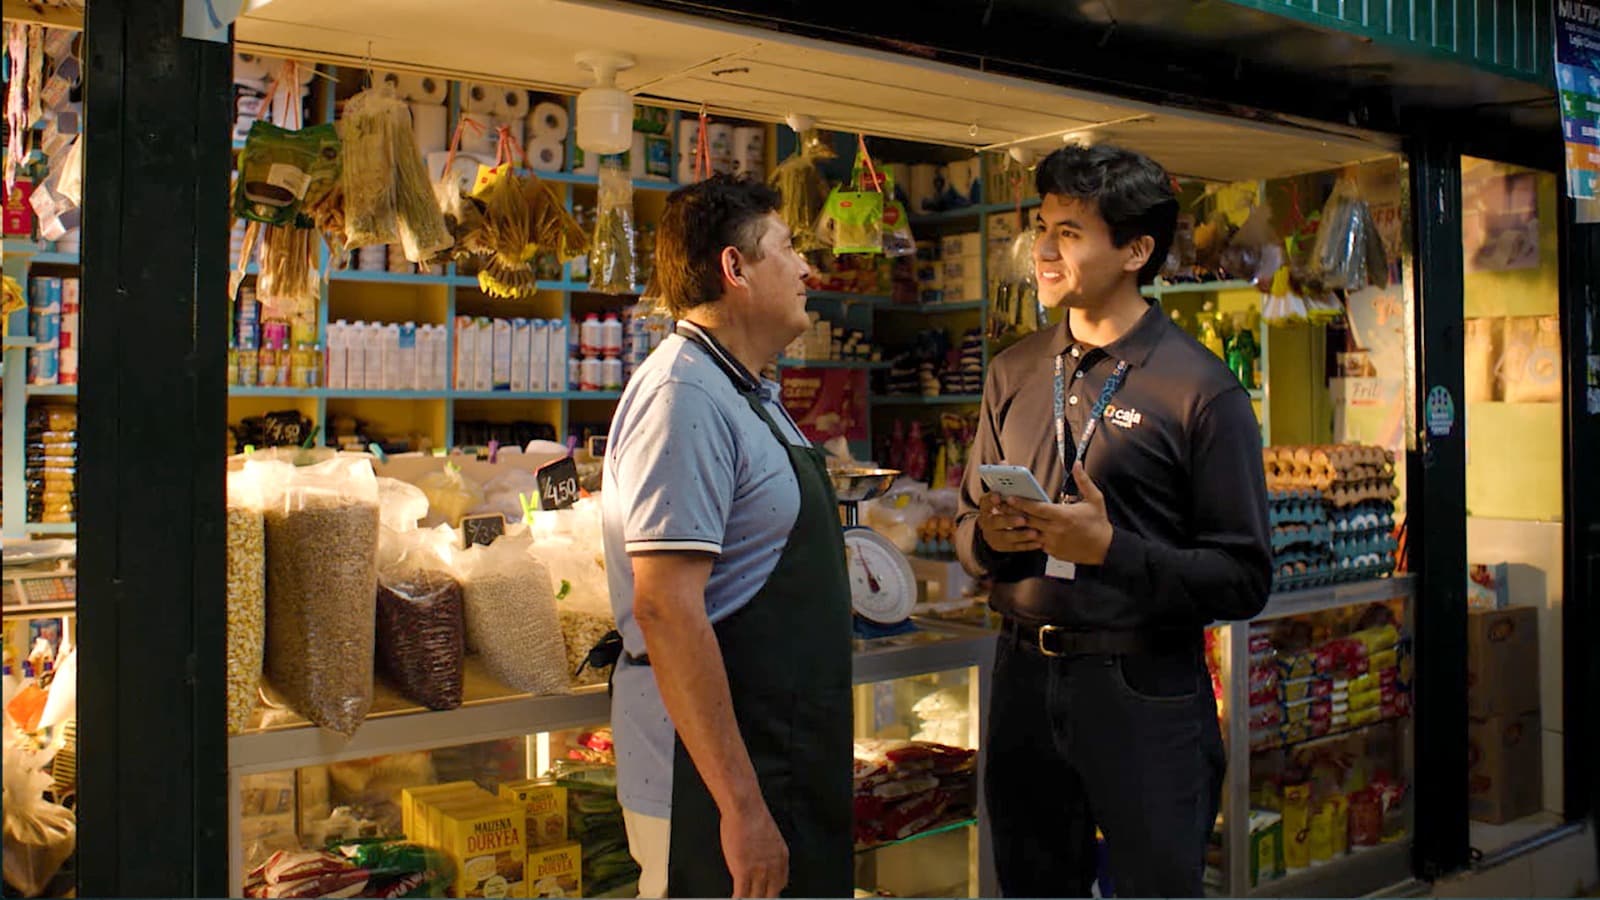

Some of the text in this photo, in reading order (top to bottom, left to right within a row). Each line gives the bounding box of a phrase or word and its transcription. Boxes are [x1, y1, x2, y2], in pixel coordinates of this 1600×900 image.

[1115, 408, 1142, 426] caja
[474, 817, 512, 834] MAIZENA
[467, 828, 519, 852] DURYEA
